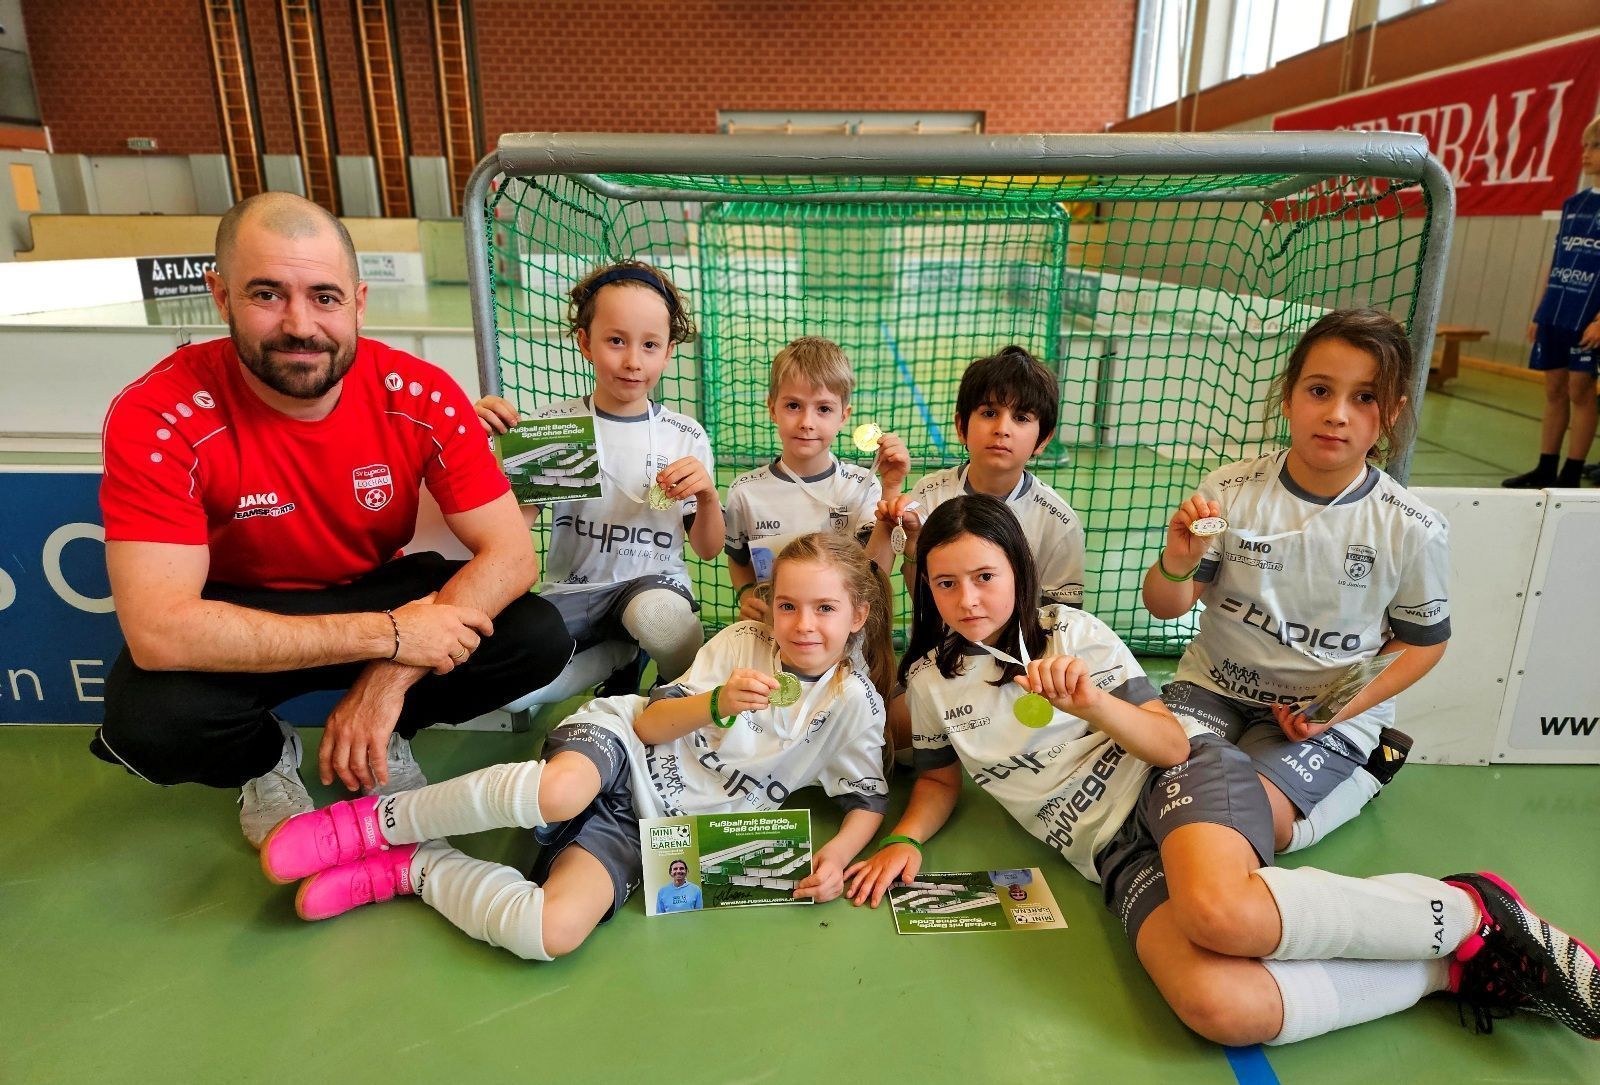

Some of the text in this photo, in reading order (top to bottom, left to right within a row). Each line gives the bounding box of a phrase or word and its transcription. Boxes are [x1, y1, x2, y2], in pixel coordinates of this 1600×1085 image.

[661, 416, 701, 440] Mangold
[357, 477, 389, 488] LOCHAU
[239, 492, 278, 509] JAKO
[1034, 494, 1070, 525] Mangold
[1381, 492, 1433, 528] Mangold
[755, 520, 781, 530] JAKO
[575, 515, 673, 553] typico
[1239, 539, 1272, 553] JAKO
[1405, 606, 1441, 618] WALTER
[851, 670, 879, 715] Mangold
[944, 704, 973, 720] JAKO
[1197, 710, 1229, 728] Schiller
[1299, 743, 1324, 770] 16
[1281, 754, 1313, 783] JAKO
[1166, 782, 1181, 798] 9
[1160, 796, 1193, 819] JAKO
[709, 817, 790, 828] Fußball mit Bande,
[723, 825, 747, 833] Spaß
[652, 828, 673, 836] MINI
[659, 841, 688, 849] ARENA
[1430, 899, 1445, 955] JAKO
